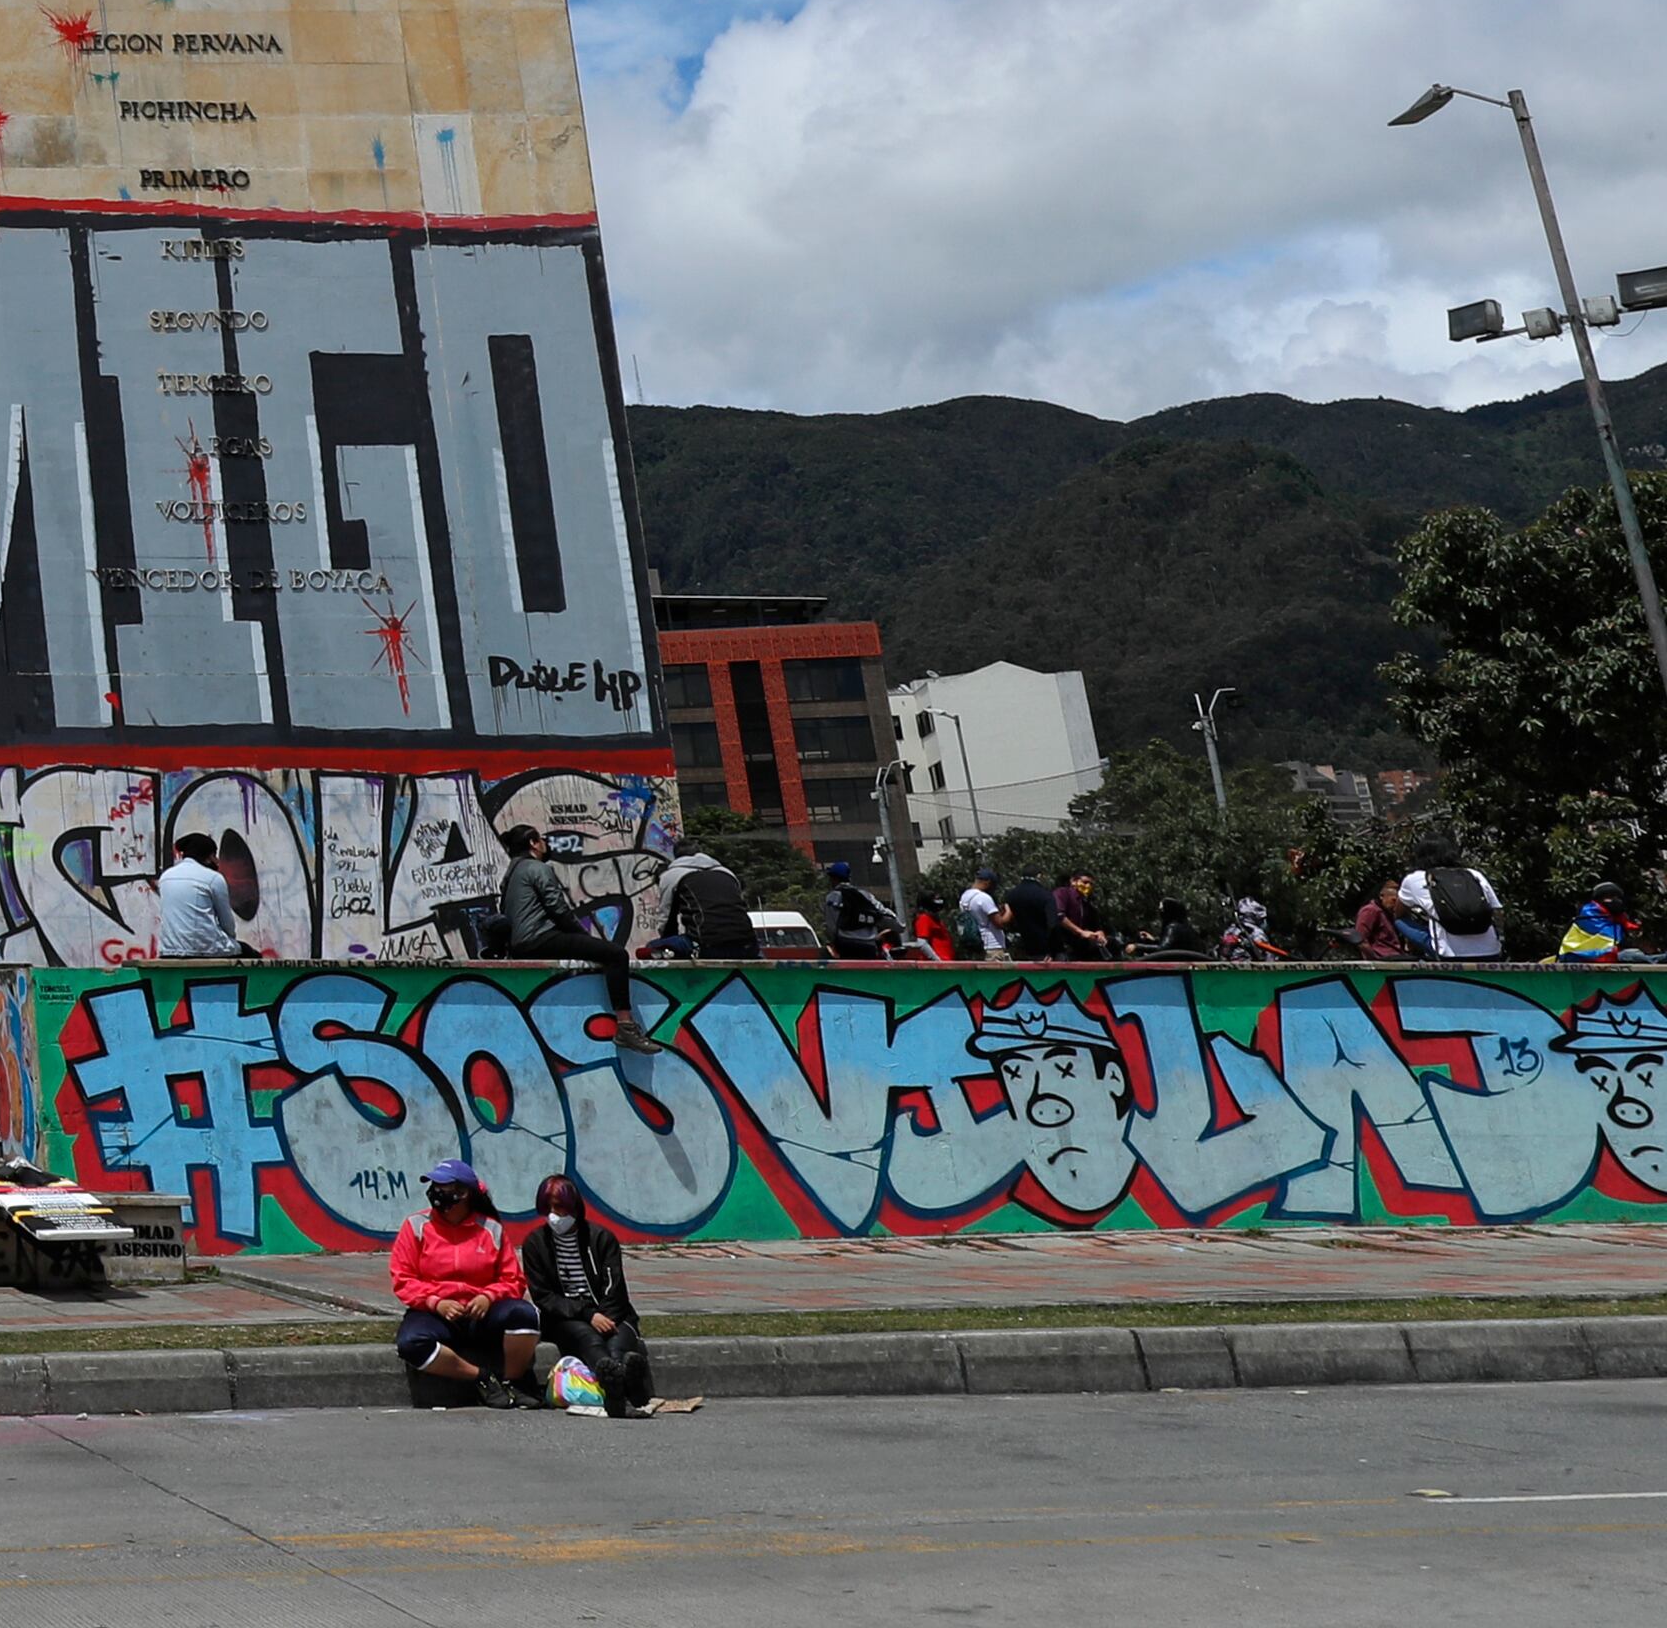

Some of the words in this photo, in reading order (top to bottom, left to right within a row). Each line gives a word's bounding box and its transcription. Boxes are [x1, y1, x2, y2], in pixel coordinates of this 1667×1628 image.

[77, 34, 163, 54] LEGION
[172, 34, 283, 55] PERVANA
[119, 101, 256, 123] PICHINCHA
[140, 169, 251, 191] PRIMERO
[160, 239, 245, 260] RIFLES
[149, 310, 270, 332] SEGVNDO
[158, 374, 273, 396] TERCERO
[94, 568, 239, 591] VENCEDOR
[249, 570, 282, 590] DE
[290, 569, 392, 592] BOYACA
[112, 1243, 183, 1258] ASESINO
